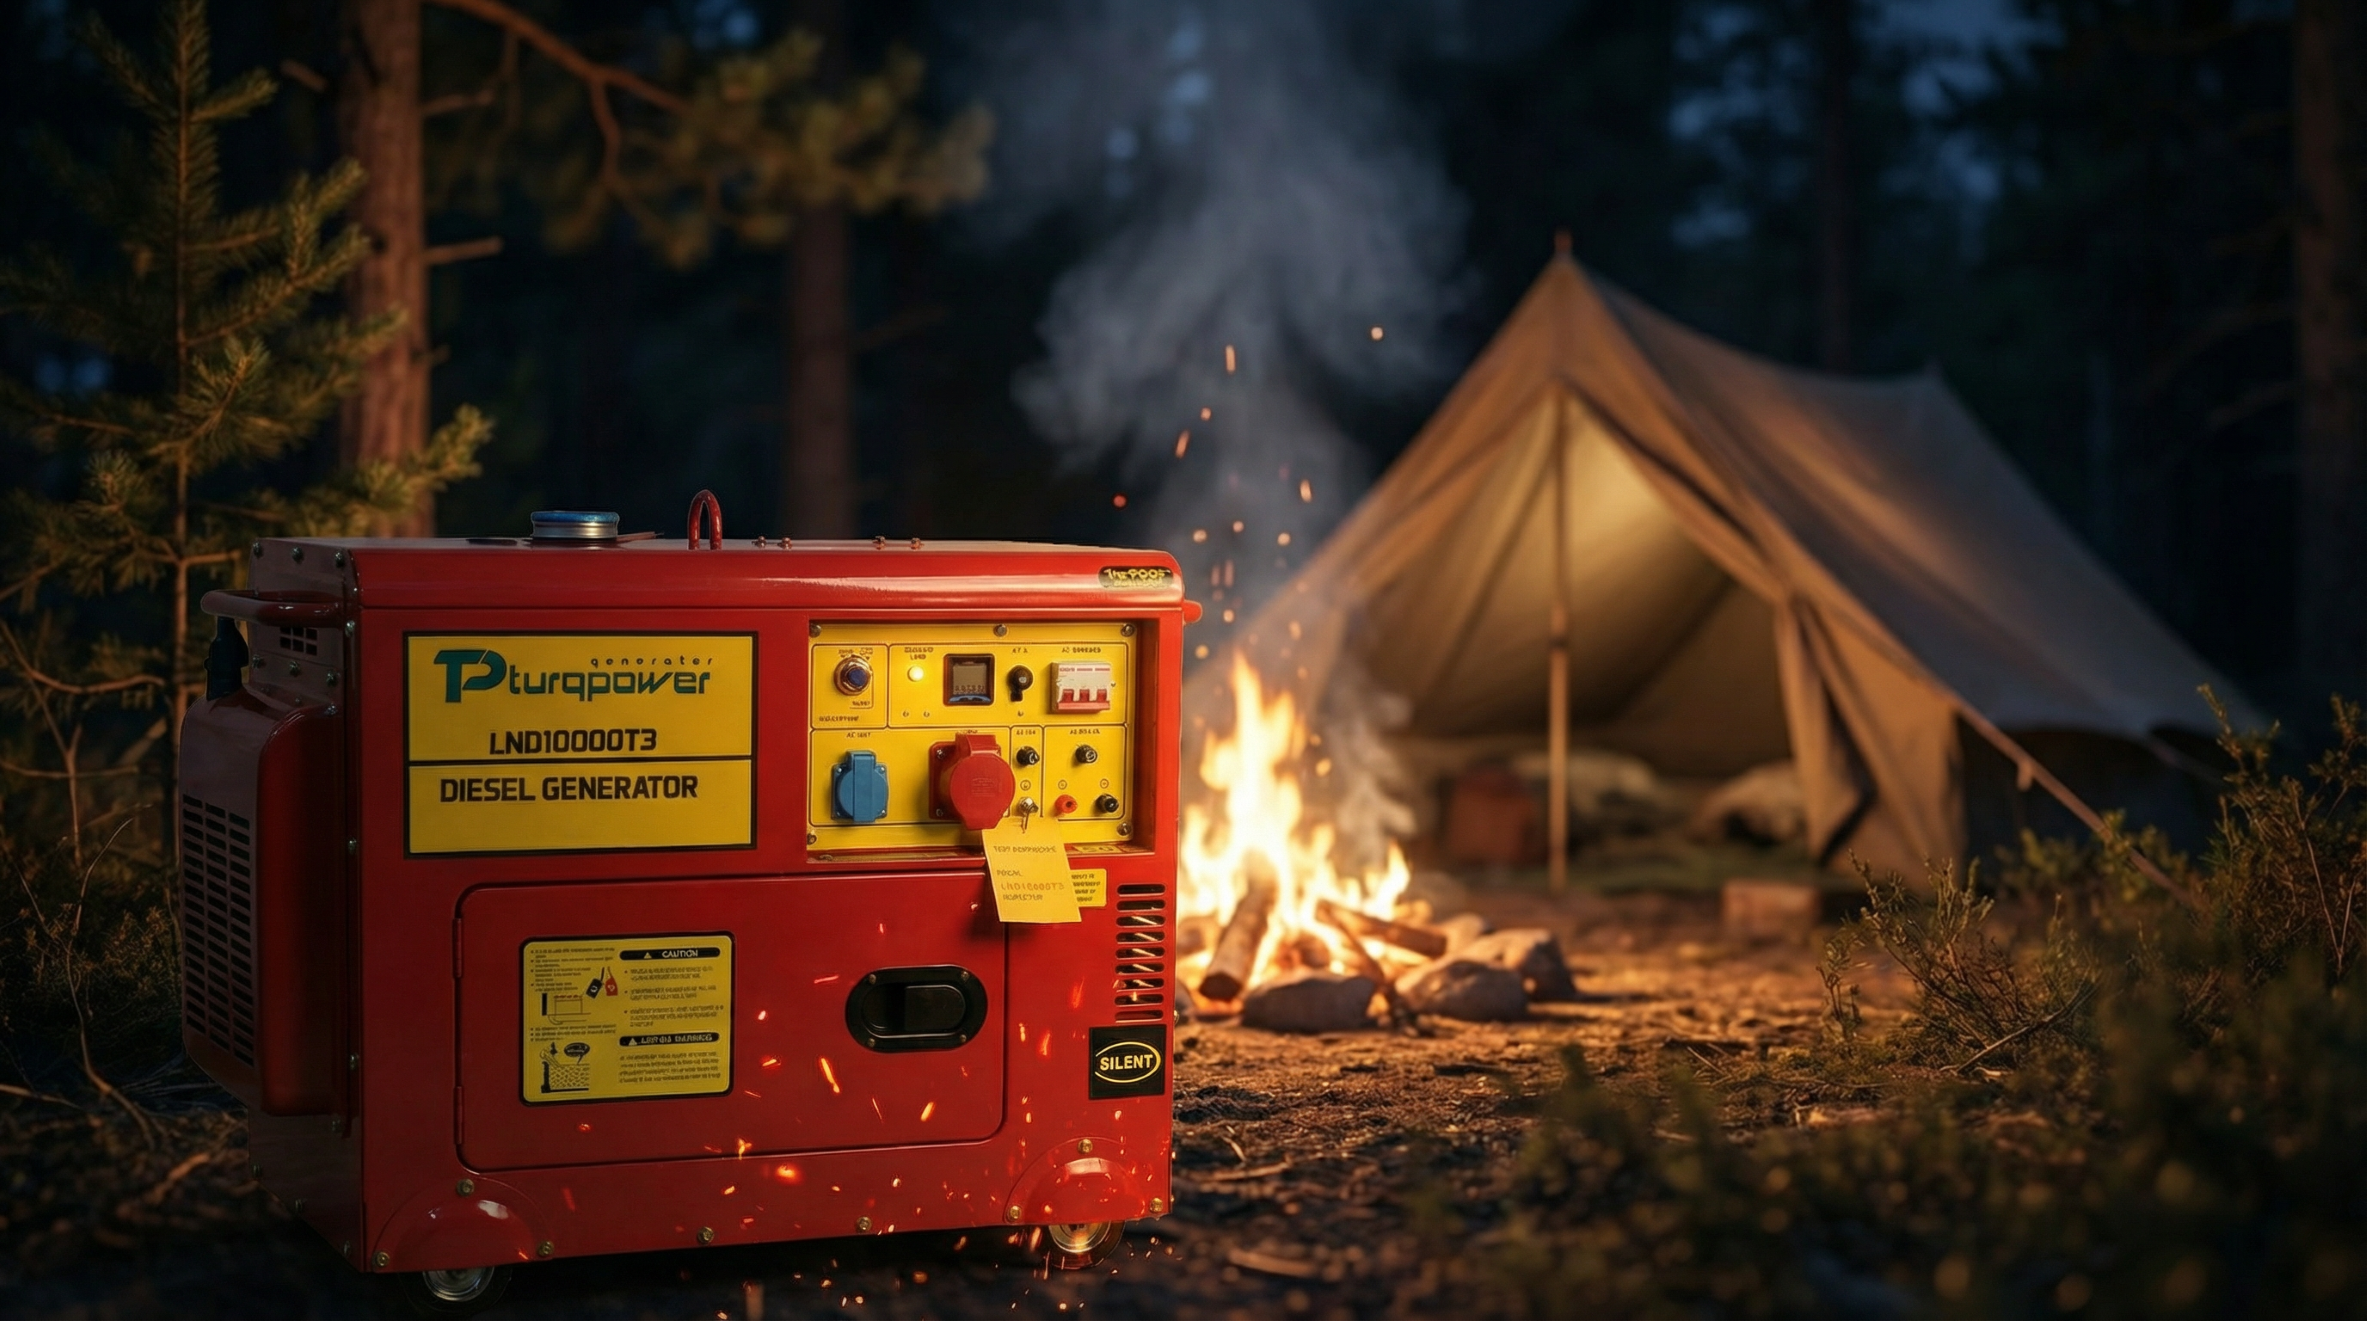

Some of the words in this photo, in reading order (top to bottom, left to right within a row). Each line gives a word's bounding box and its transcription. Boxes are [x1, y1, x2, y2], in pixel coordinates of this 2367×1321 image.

[489, 728, 657, 755] LND10000T3
[440, 777, 536, 803] DIESEL
[542, 775, 698, 800] GENERATOR
[661, 949, 699, 959] CAUTION
[1100, 1054, 1154, 1071] SILENT
